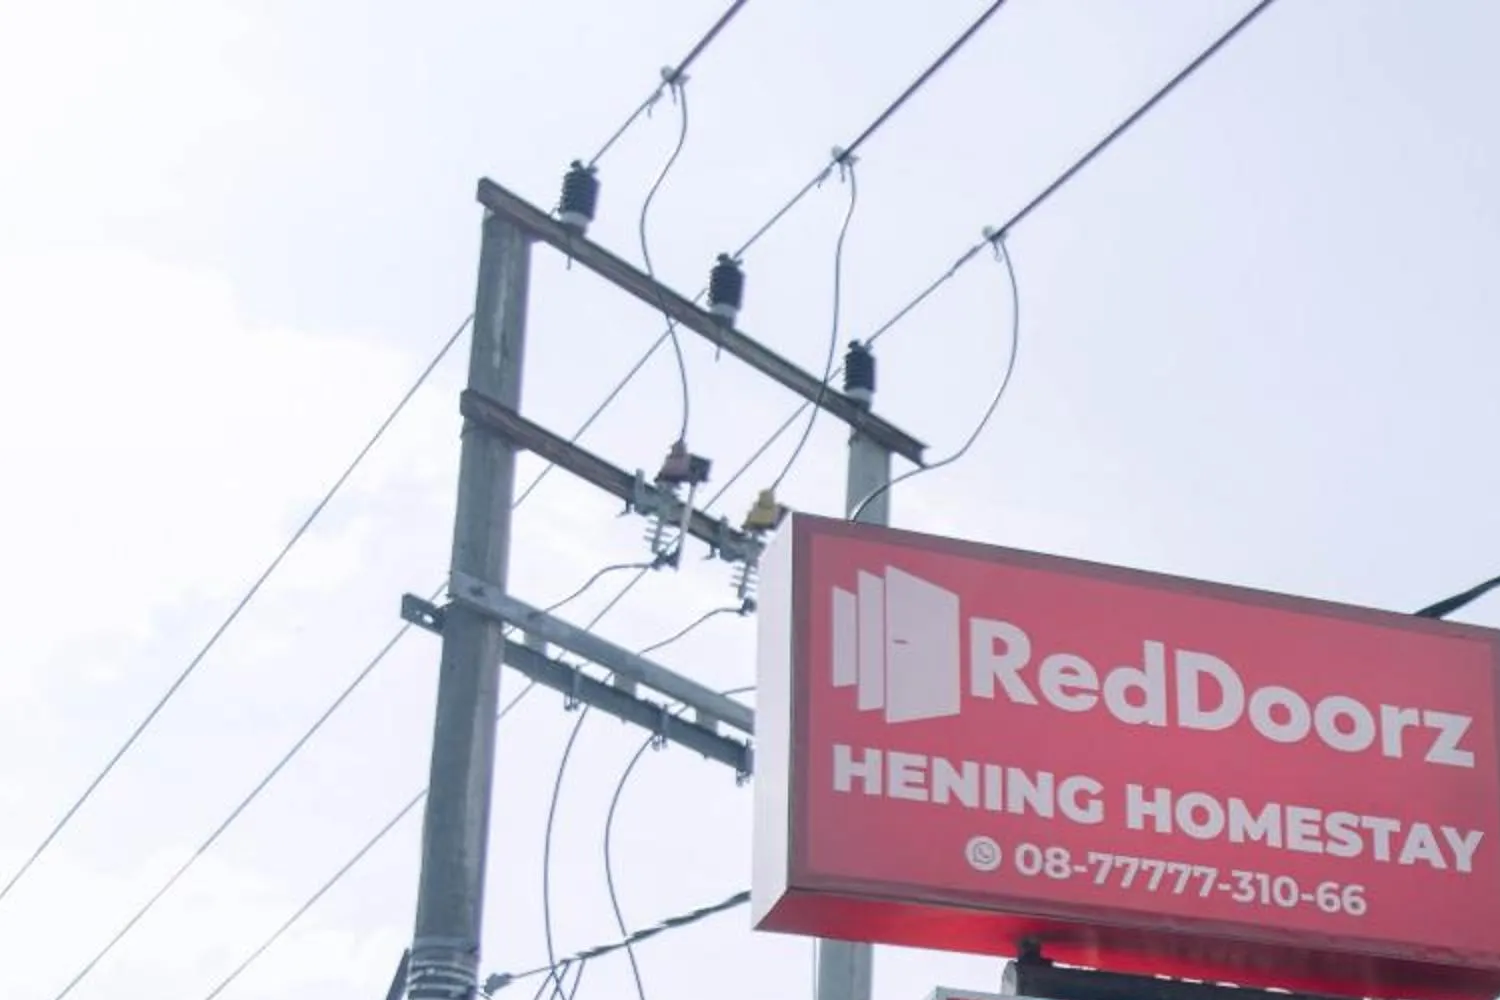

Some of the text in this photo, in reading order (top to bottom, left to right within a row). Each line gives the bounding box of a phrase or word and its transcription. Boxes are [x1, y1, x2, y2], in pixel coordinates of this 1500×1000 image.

[969, 616, 1475, 768] RedDoorz
[832, 744, 1484, 873] HENING HOMESTAY
[1014, 842, 1367, 917] 08-77777-310-66
